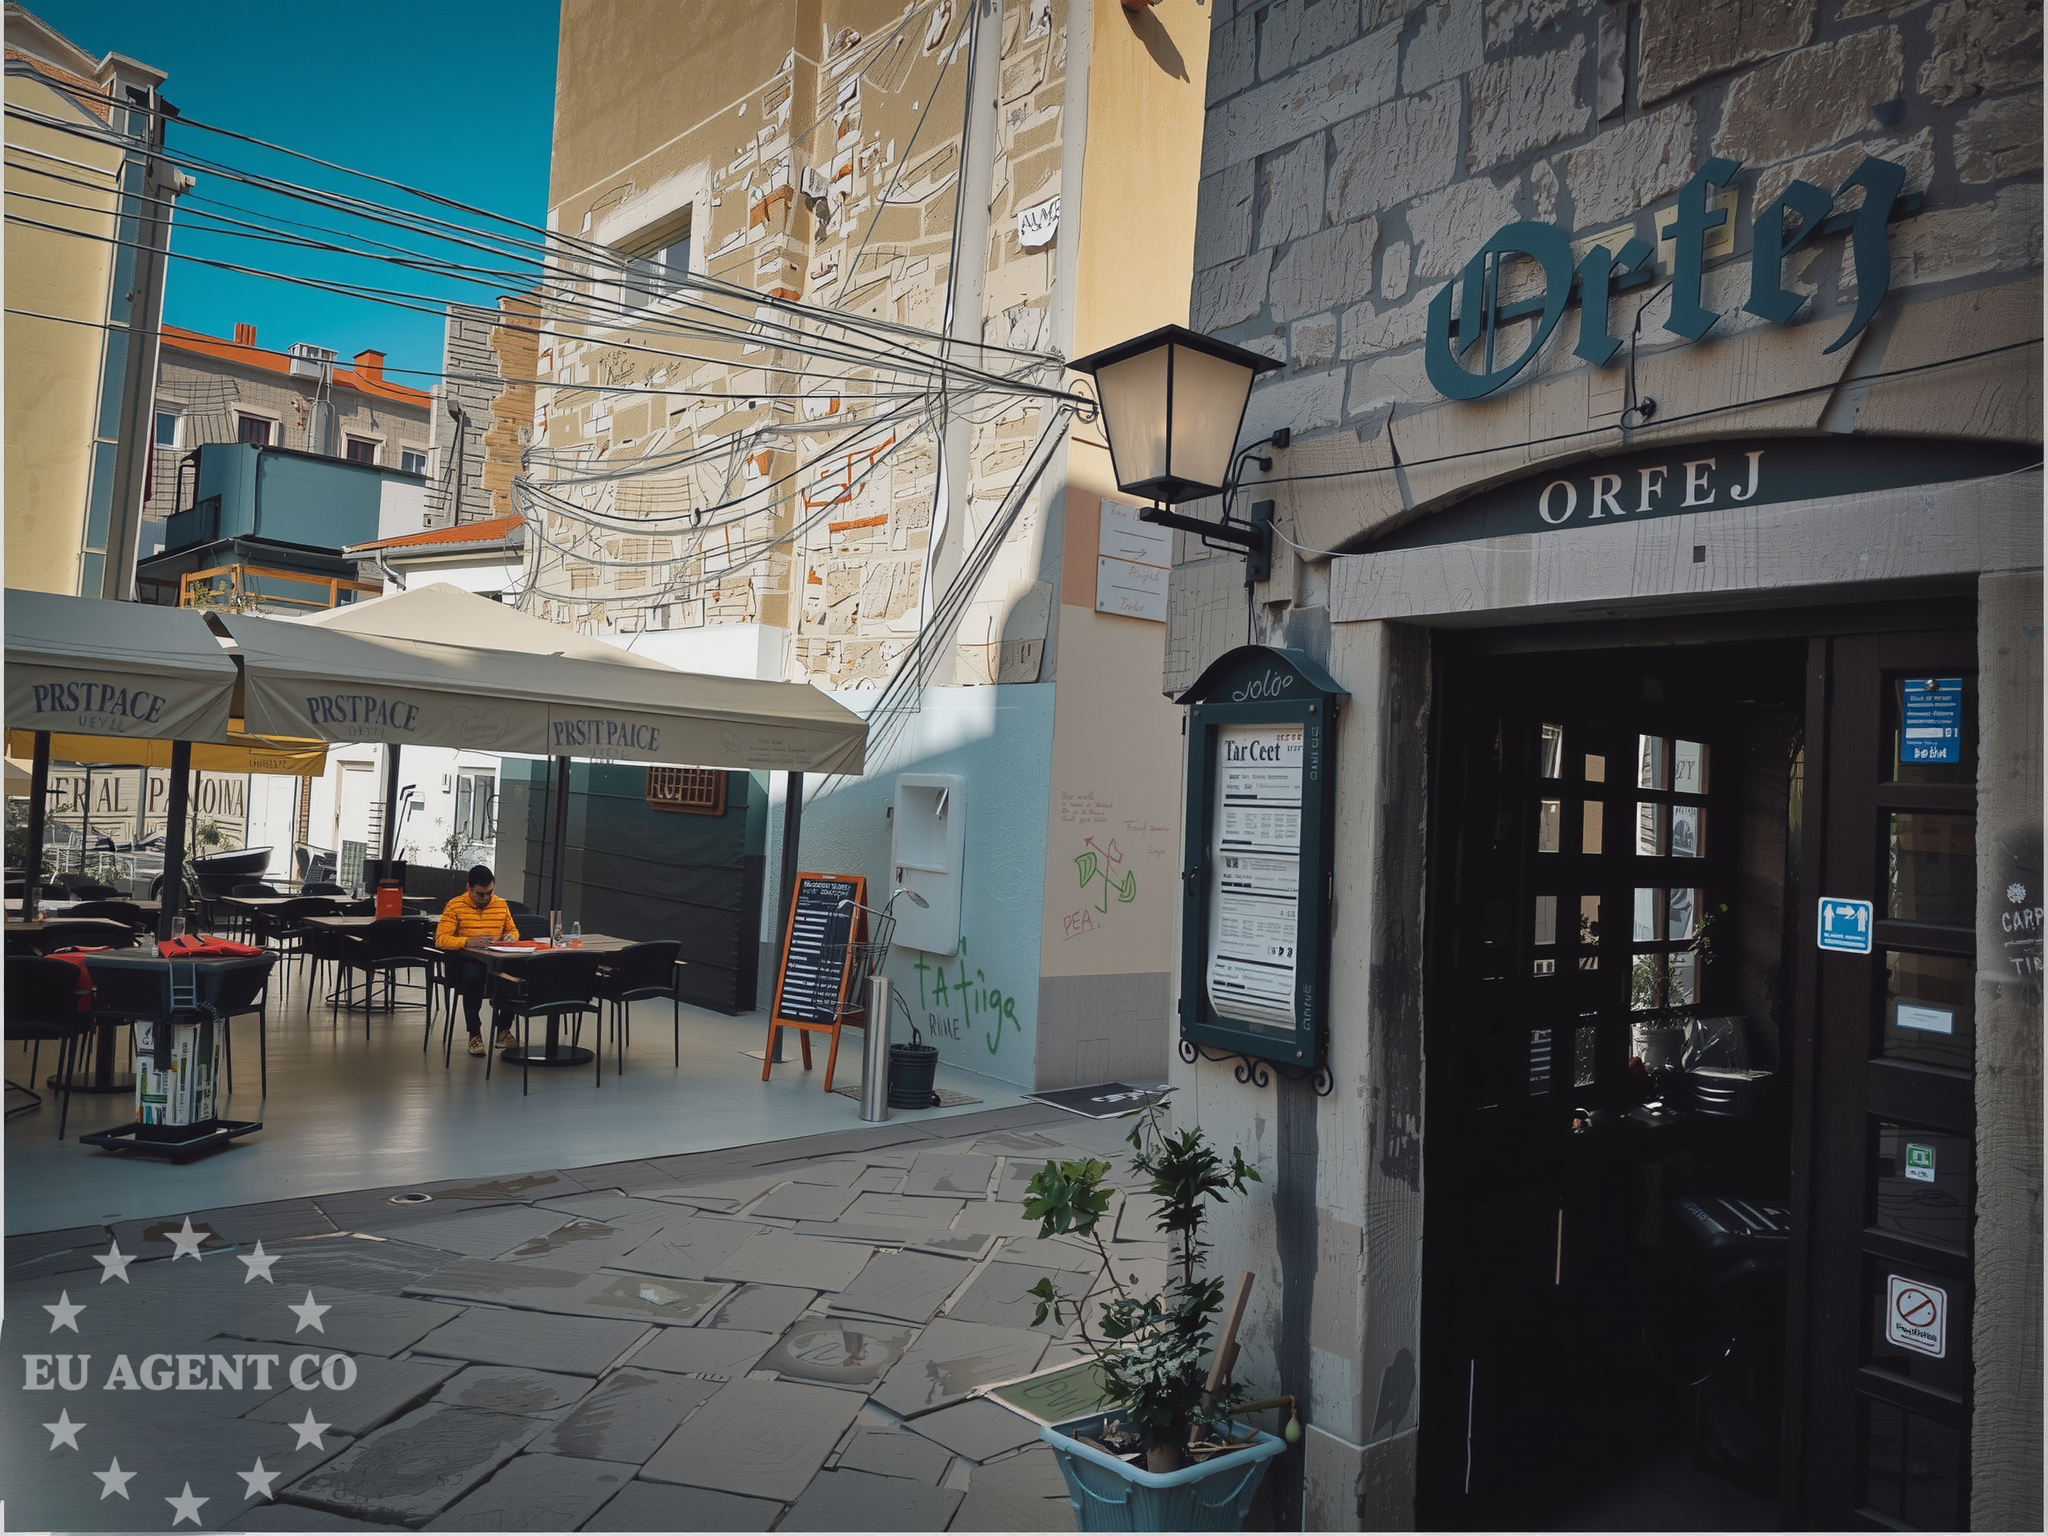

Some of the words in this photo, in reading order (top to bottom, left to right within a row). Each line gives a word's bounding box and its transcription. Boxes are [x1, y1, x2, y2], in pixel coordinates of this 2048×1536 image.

[1425, 155, 1906, 400] Orfej
[1538, 450, 1765, 525] ORFEJ
[32, 681, 167, 724] PRSTPACE
[306, 694, 420, 732] PRSTPACE
